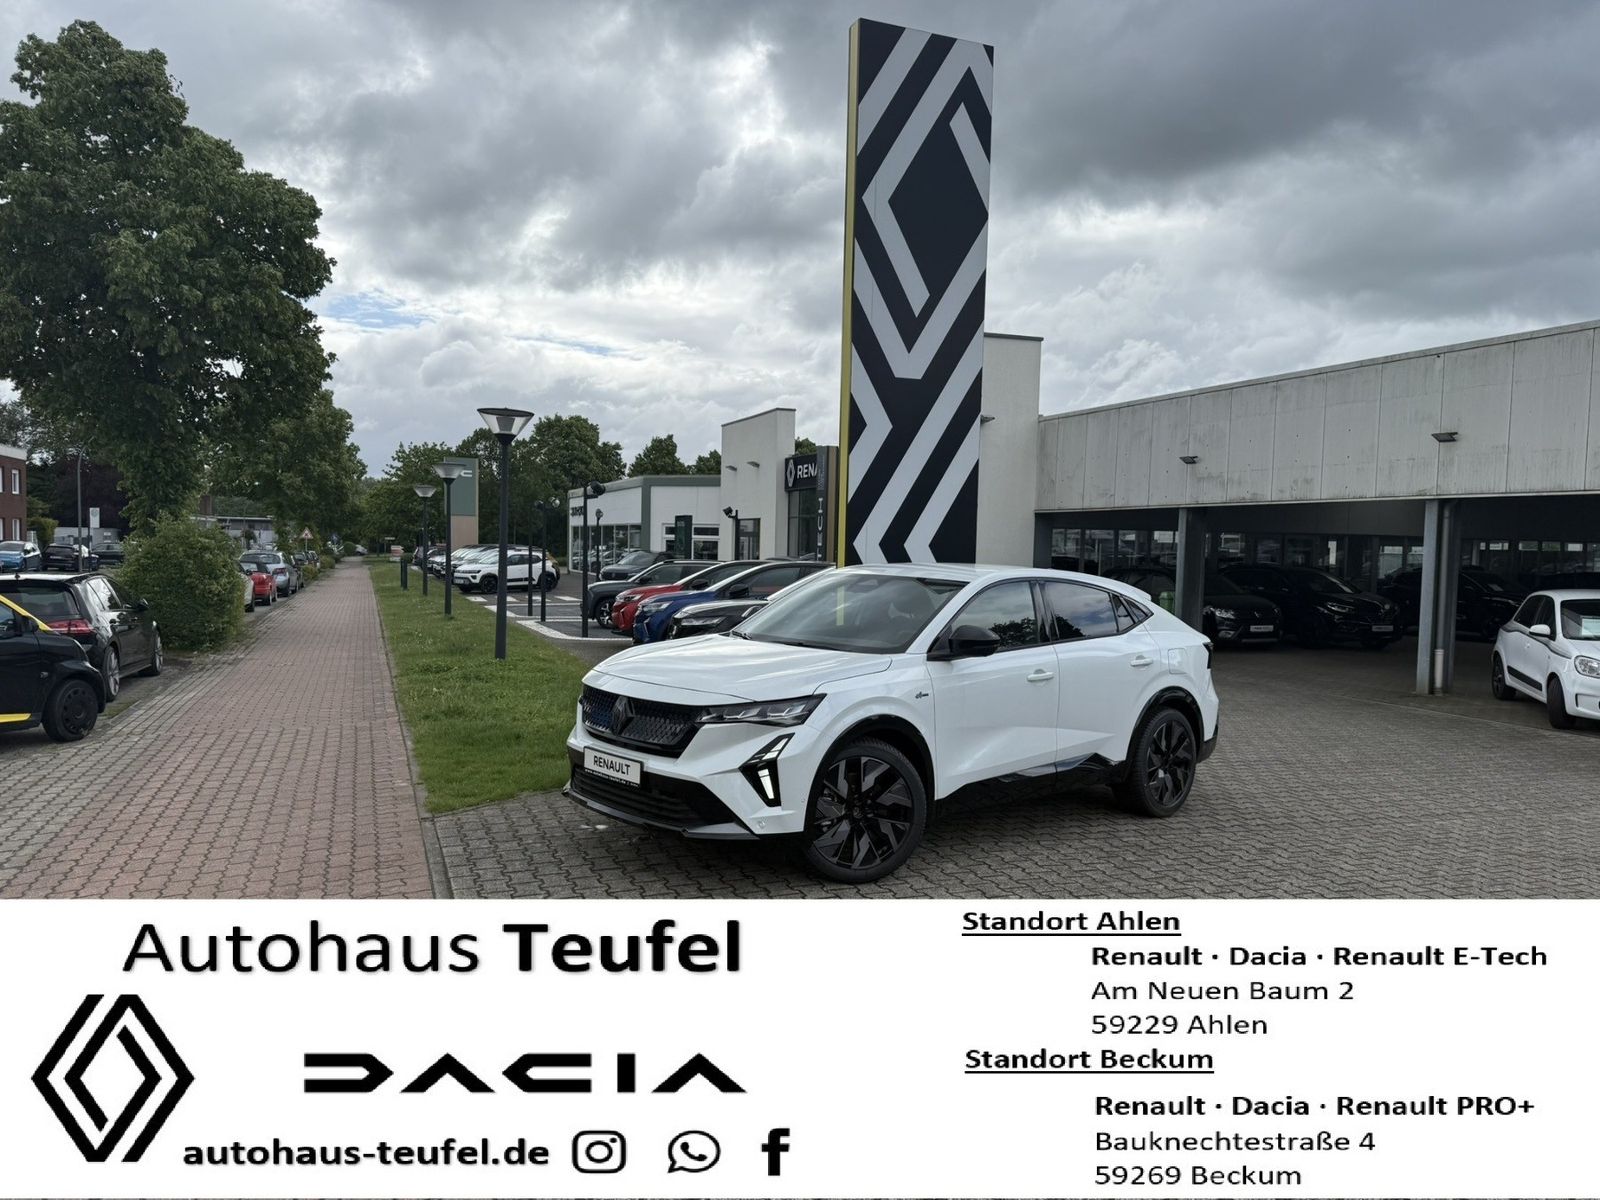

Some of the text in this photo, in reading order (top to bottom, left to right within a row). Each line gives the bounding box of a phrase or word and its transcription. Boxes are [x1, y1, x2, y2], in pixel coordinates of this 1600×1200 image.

[797, 463, 818, 478] RENA
[816, 497, 824, 561] TECH
[593, 754, 631, 776] RENAULT
